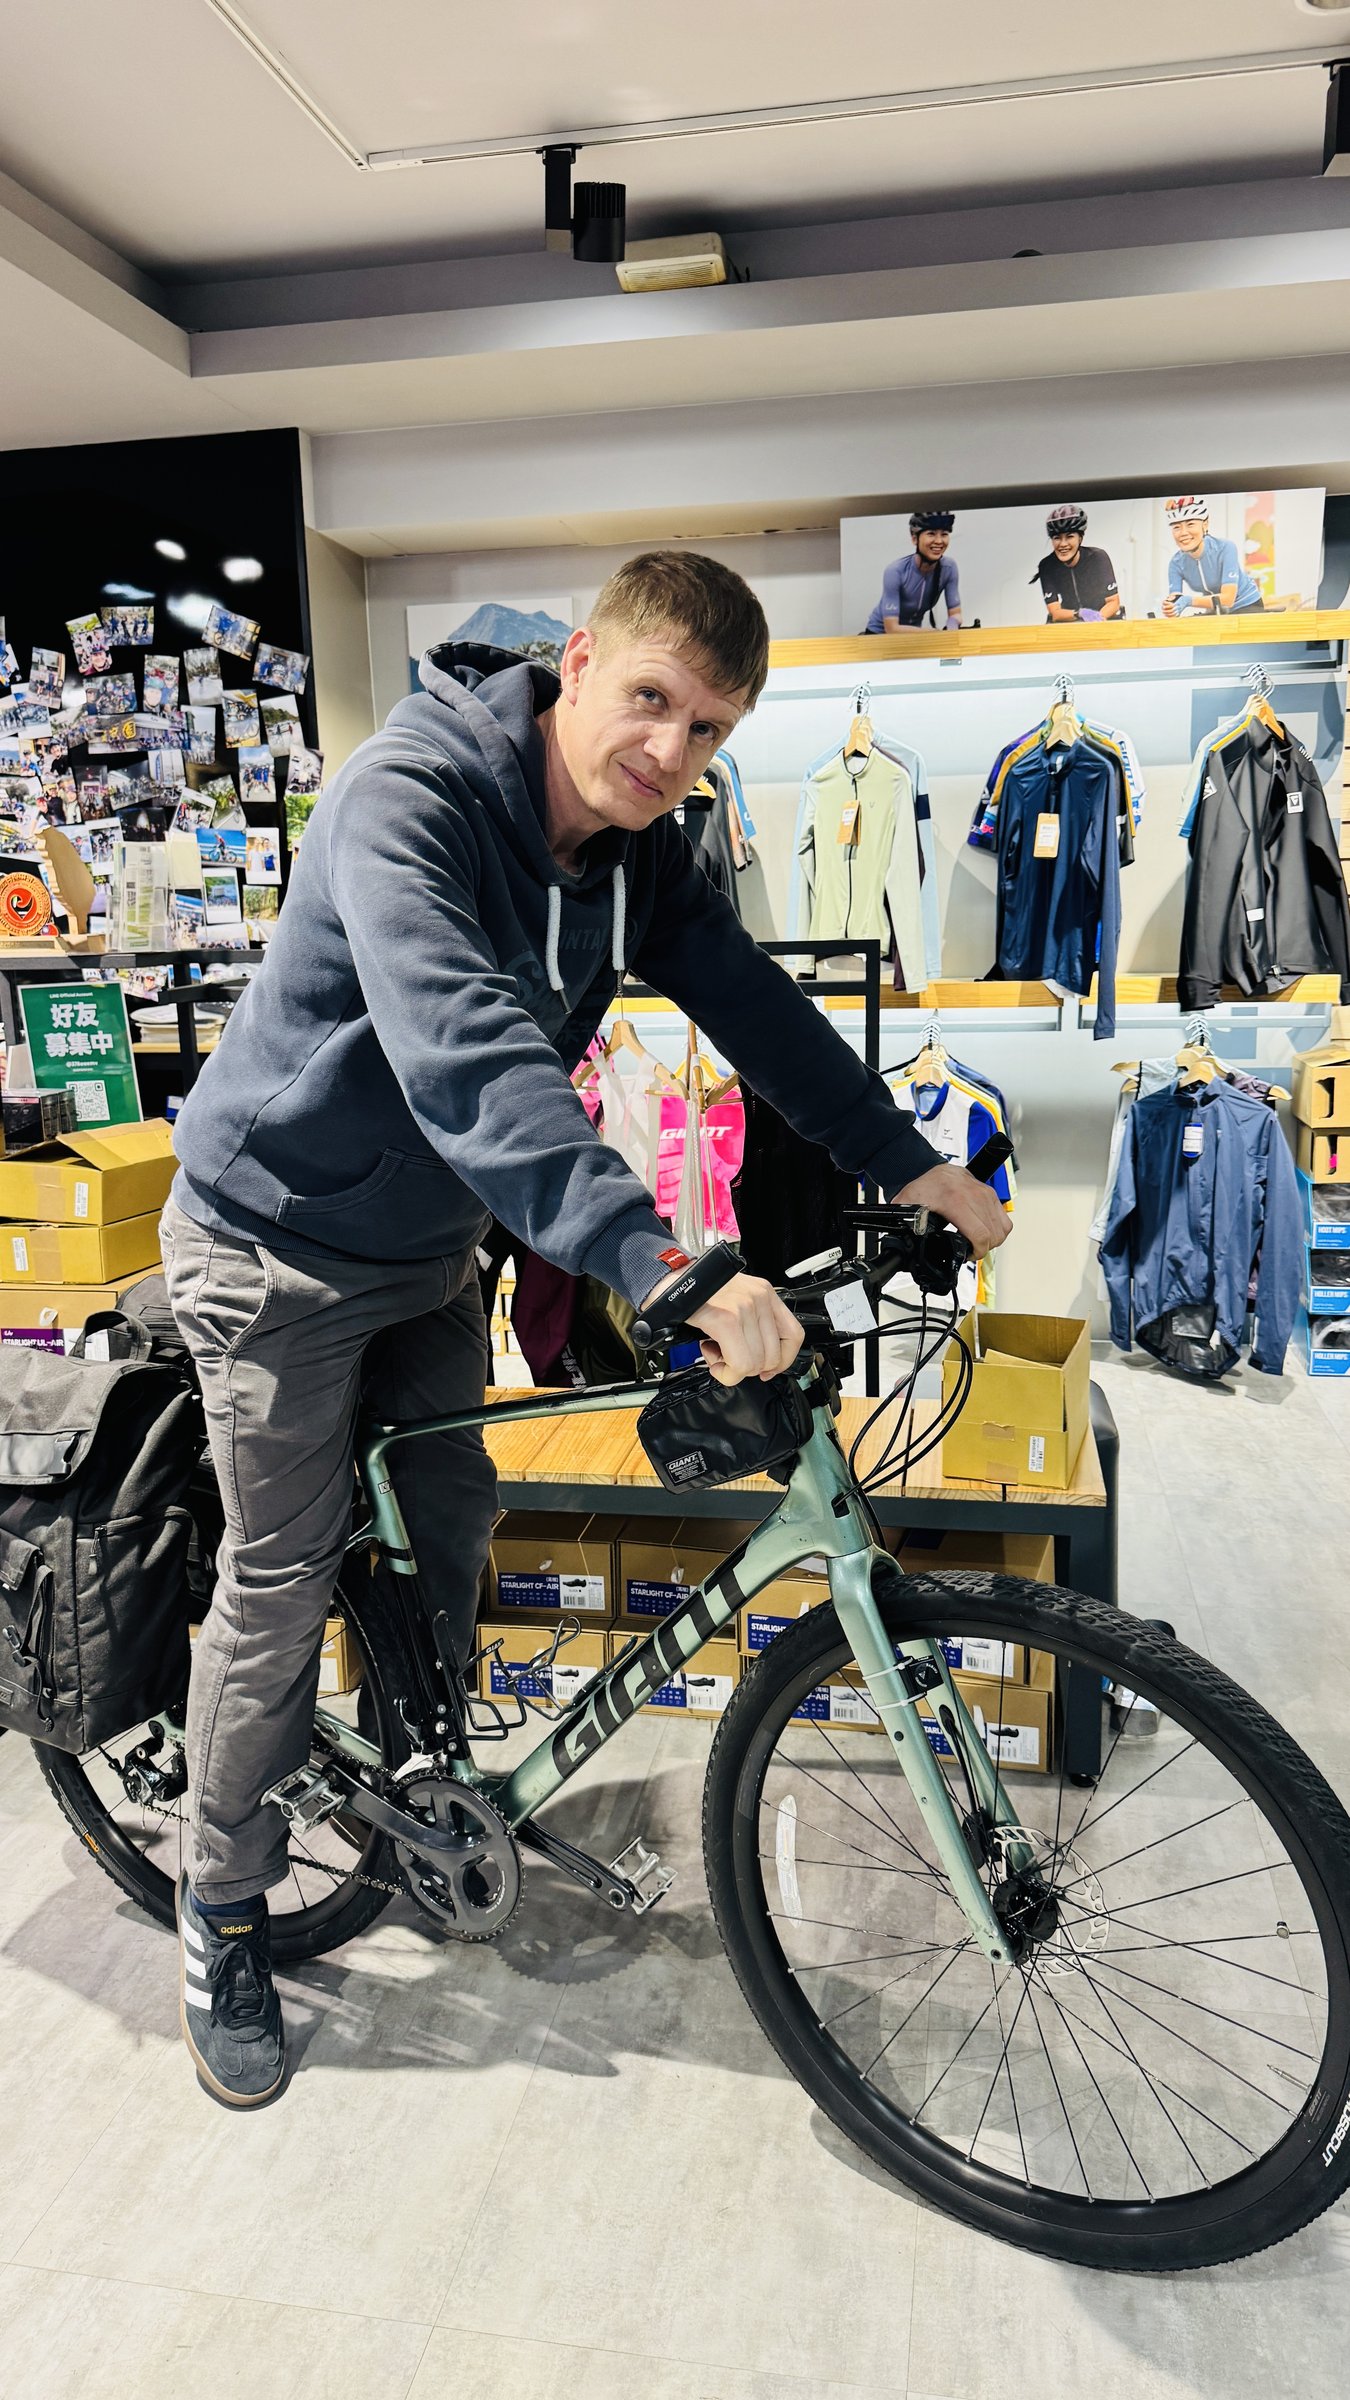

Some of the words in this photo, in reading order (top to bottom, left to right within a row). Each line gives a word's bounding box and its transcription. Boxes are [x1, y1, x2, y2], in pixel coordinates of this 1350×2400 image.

[50, 1001, 99, 1029] 好友
[43, 1030, 114, 1058] 募集中
[659, 1126, 733, 1140] GINT
[667, 1282, 690, 1302] CONTACT
[669, 1453, 697, 1470] GIANT
[501, 1581, 534, 1589] STARLIGHT
[535, 1582, 560, 1590] CF-AIR
[630, 1587, 664, 1598] STARLIGHT
[552, 1536, 752, 1780] GIANT
[220, 1924, 253, 1934] adidas
